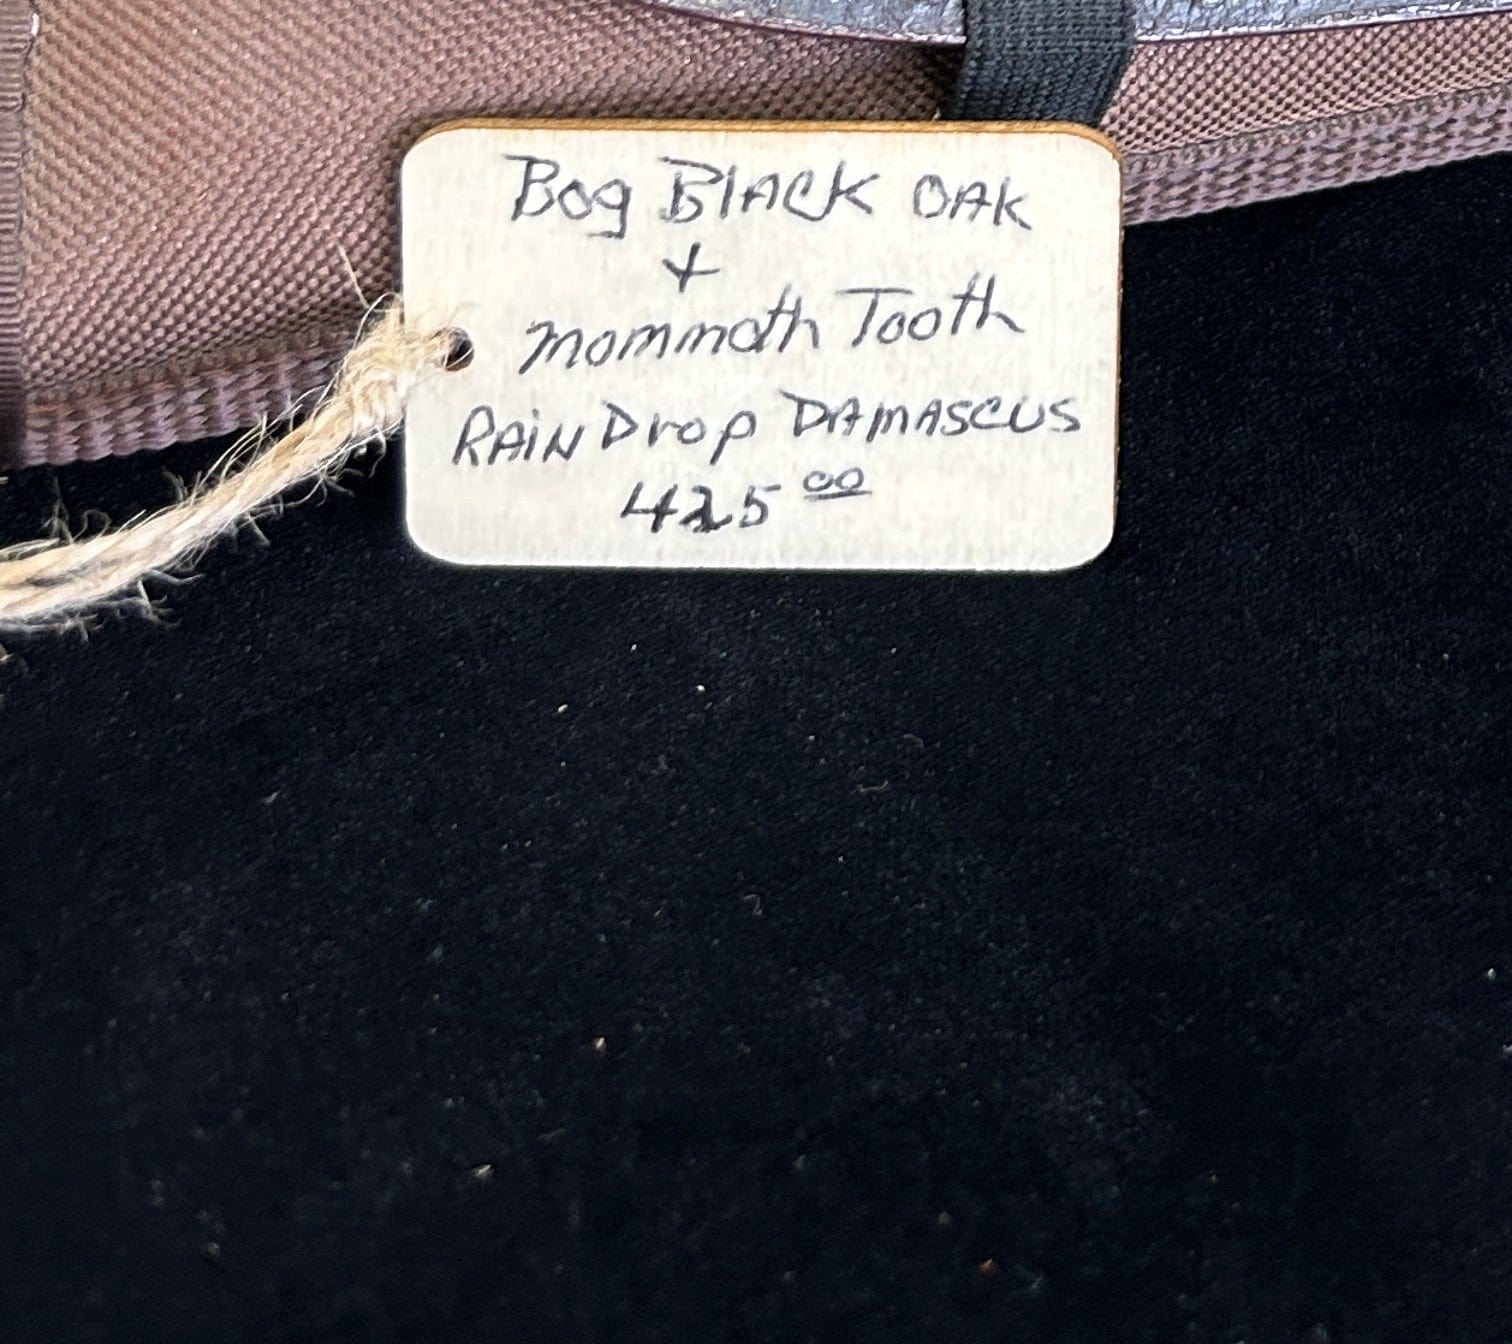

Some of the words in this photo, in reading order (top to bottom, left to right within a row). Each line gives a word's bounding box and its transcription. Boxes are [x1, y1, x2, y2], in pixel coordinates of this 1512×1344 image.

[504, 153, 632, 239] Bog
[662, 241, 721, 292] +
[836, 273, 1025, 346] Tooth
